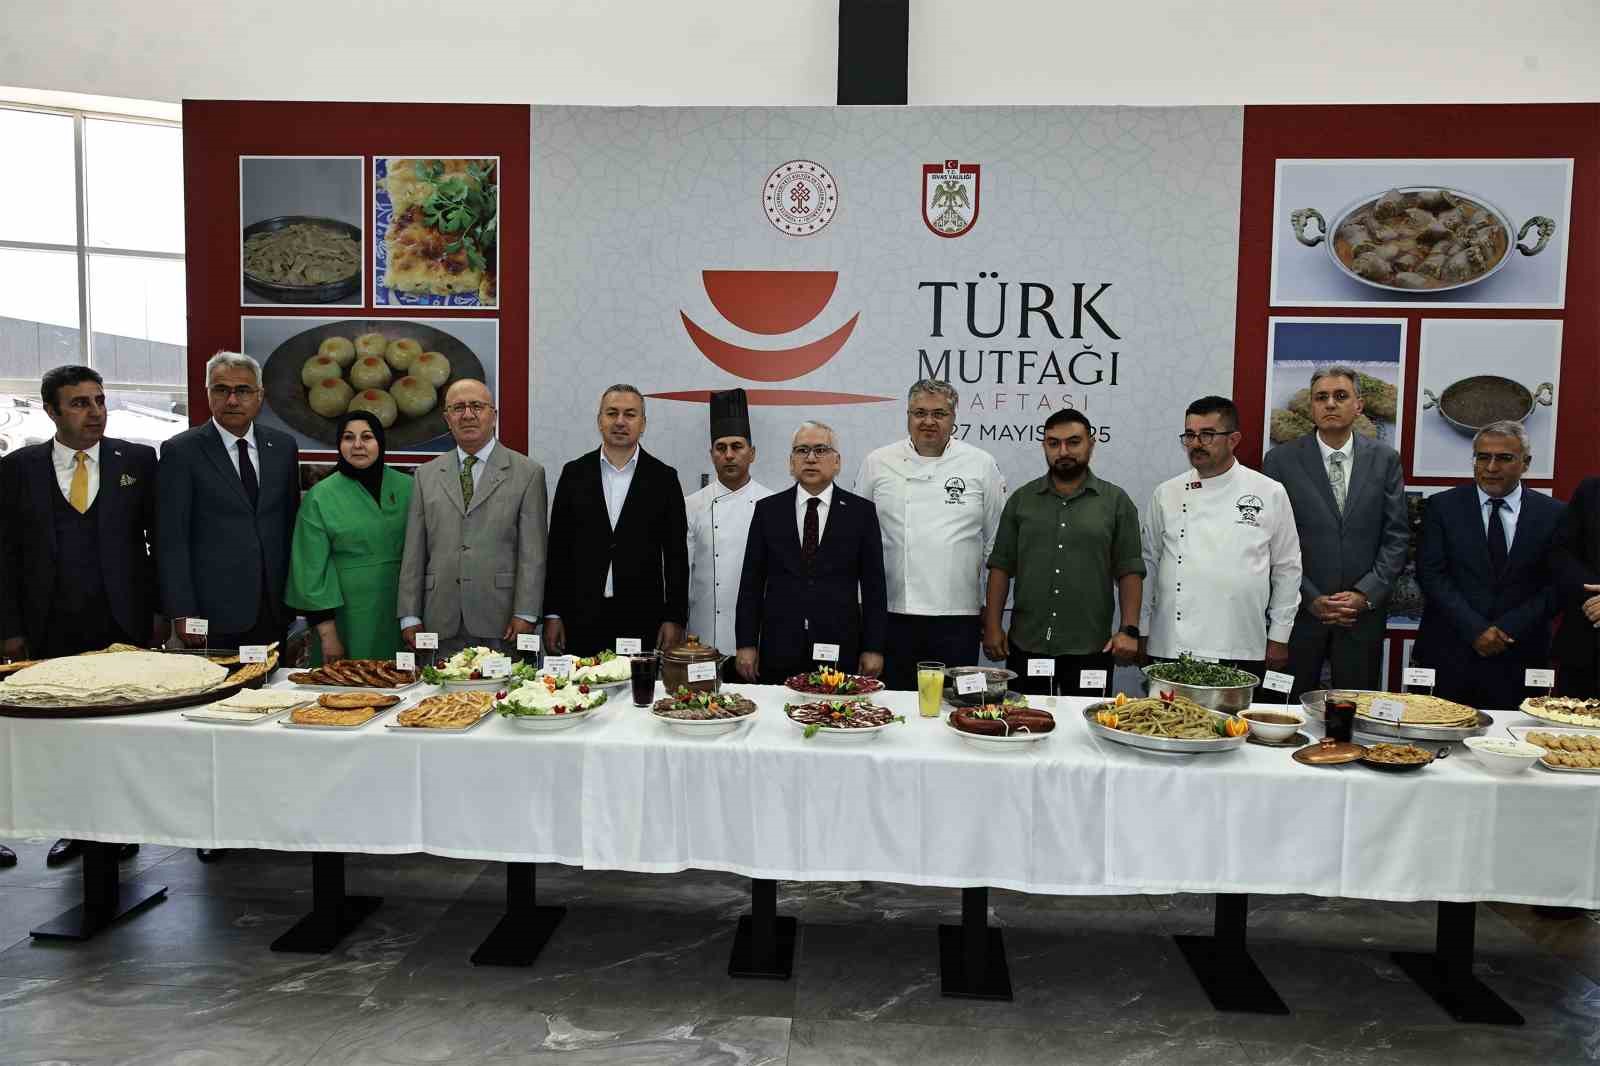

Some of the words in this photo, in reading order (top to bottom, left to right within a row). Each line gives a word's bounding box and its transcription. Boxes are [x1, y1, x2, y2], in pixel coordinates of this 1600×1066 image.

[918, 271, 1121, 340] TÜRK
[918, 344, 1120, 386] MUTFAĞI
[980, 423, 1045, 442] MAYIS
